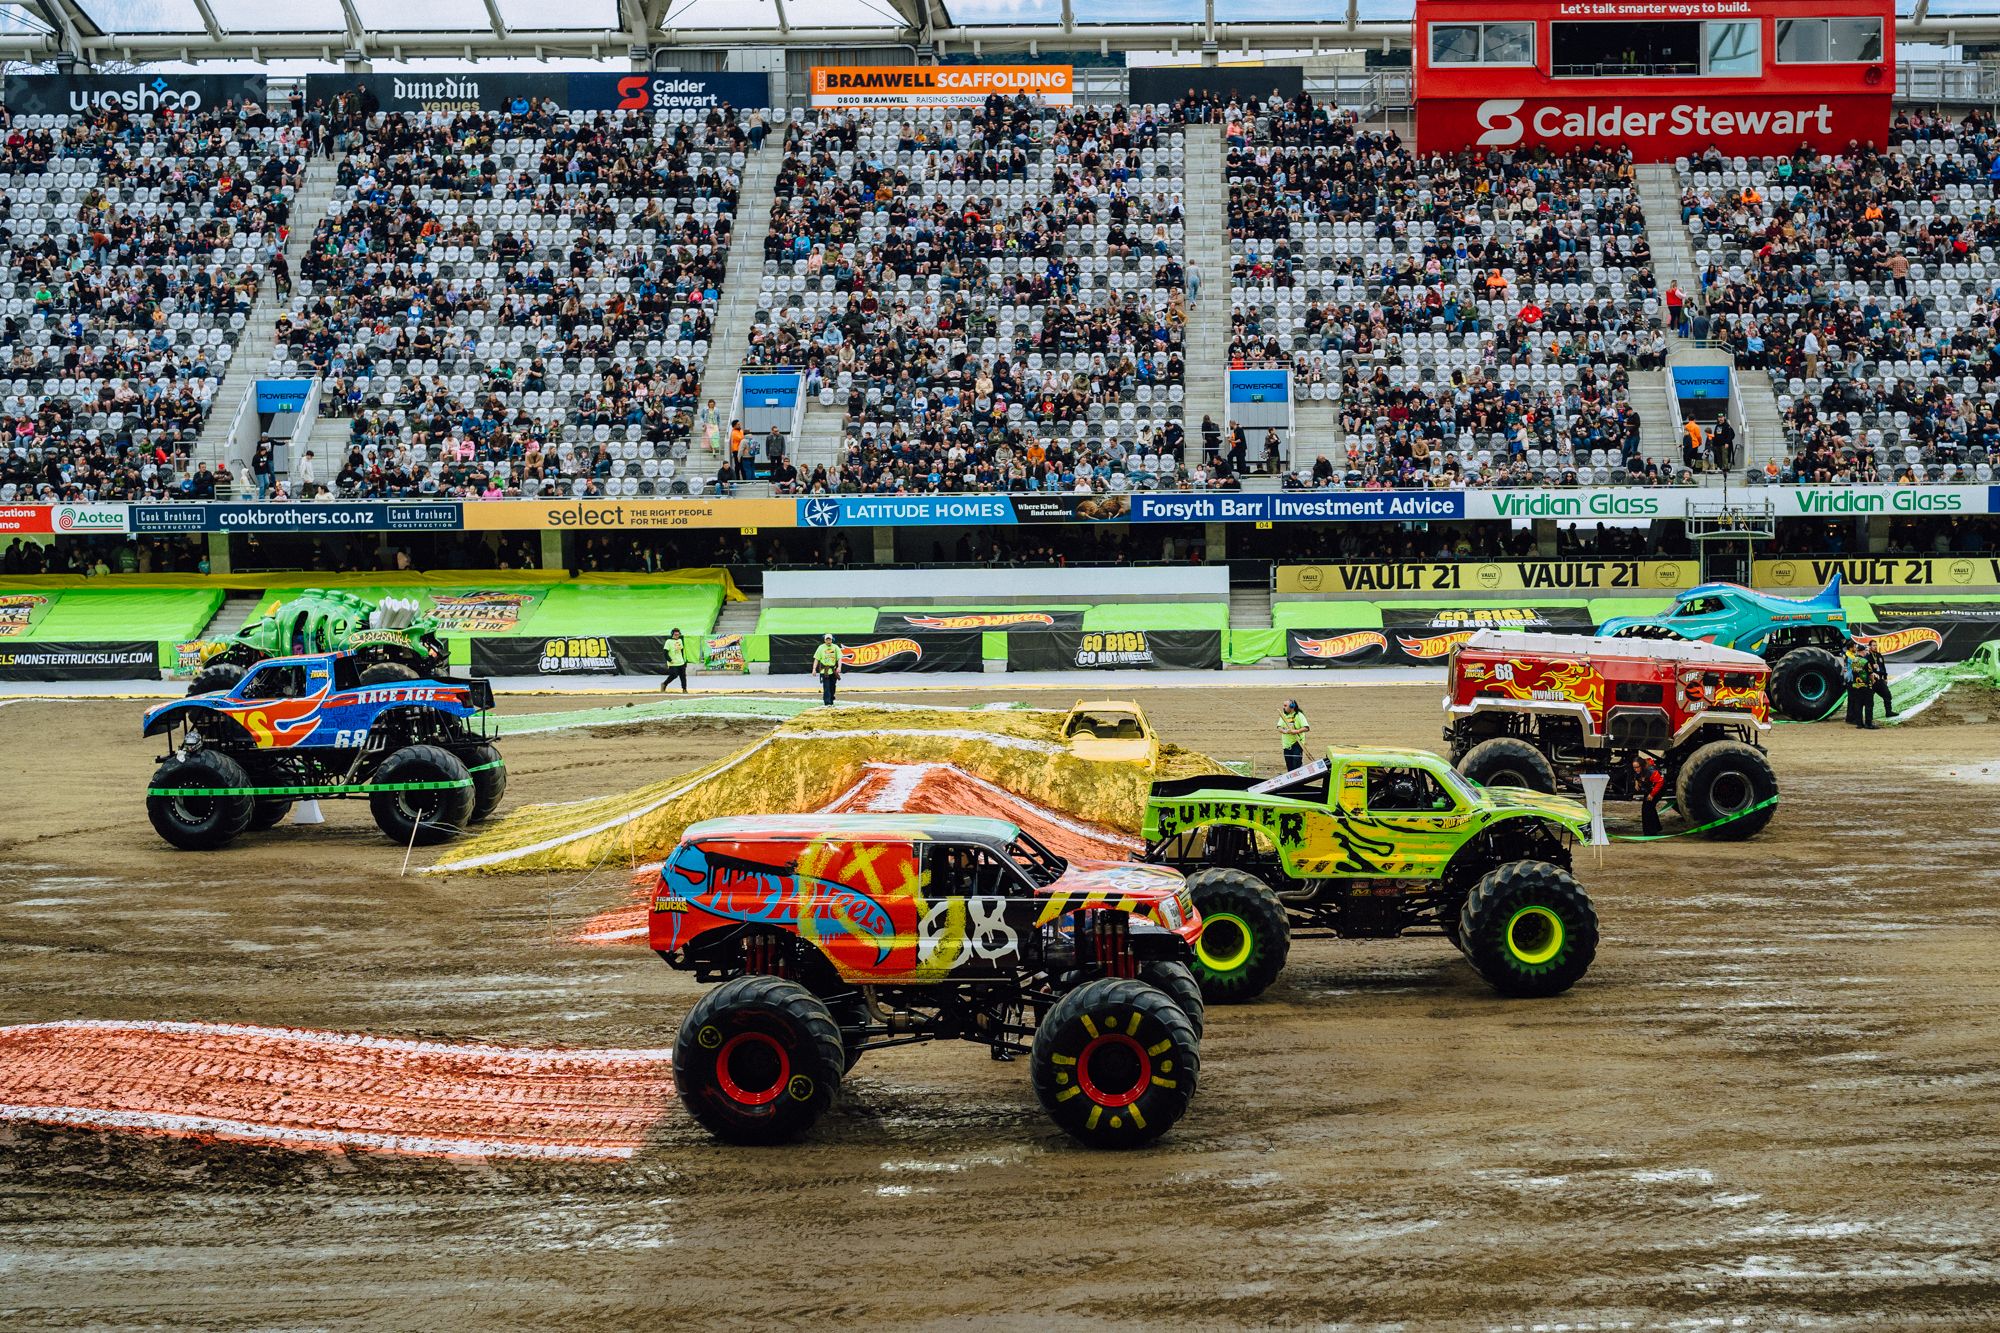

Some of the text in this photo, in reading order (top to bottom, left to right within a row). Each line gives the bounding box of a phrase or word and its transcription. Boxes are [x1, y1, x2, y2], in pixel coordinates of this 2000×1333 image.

[1561, 2, 1751, 15] Let's talk smarter ways to build.
[652, 80, 705, 93] Calder
[826, 72, 1067, 87] BRAMWELL SCAFFOLDING
[421, 101, 480, 111] venues
[652, 93, 717, 107] Stewart
[863, 96, 909, 104] BRAMWELL
[916, 96, 948, 104] RAISING
[1533, 104, 1833, 137] Calder Stewart
[745, 387, 797, 395] POWERADE
[1142, 497, 1455, 520] Forsyth Barr Investment Advice
[1492, 494, 1659, 516] Viridian Glass
[1795, 490, 1962, 513] Viridian Glass
[77, 511, 123, 523] Aotea
[140, 511, 201, 522] Cook Brothers
[219, 510, 374, 525] cookbrothers.co.nz
[392, 509, 452, 520] Cook Brothers
[548, 503, 624, 526] select
[846, 503, 1005, 519] LATITUDE HOMES
[1259, 521, 1269, 529] 04
[1339, 565, 1461, 590] VAULT 21
[1518, 563, 1640, 588] VAULT 21
[1812, 560, 1933, 585] VAULT 21
[422, 610, 518, 619] TRUCKS
[1439, 608, 1537, 621] GO BIG!
[1431, 620, 1459, 628] GO
[546, 638, 608, 658] GO BIG!
[1083, 632, 1146, 652] GO BIG!
[541, 657, 559, 670] GO
[561, 657, 581, 668] HOT
[1078, 651, 1096, 664] GO
[1098, 651, 1118, 662] HOT
[1494, 663, 1514, 681] 68
[357, 689, 437, 705] RACE ACE
[334, 729, 369, 749] 68
[1158, 802, 1305, 848] GUNKSTER
[654, 901, 689, 912] TRUCKS
